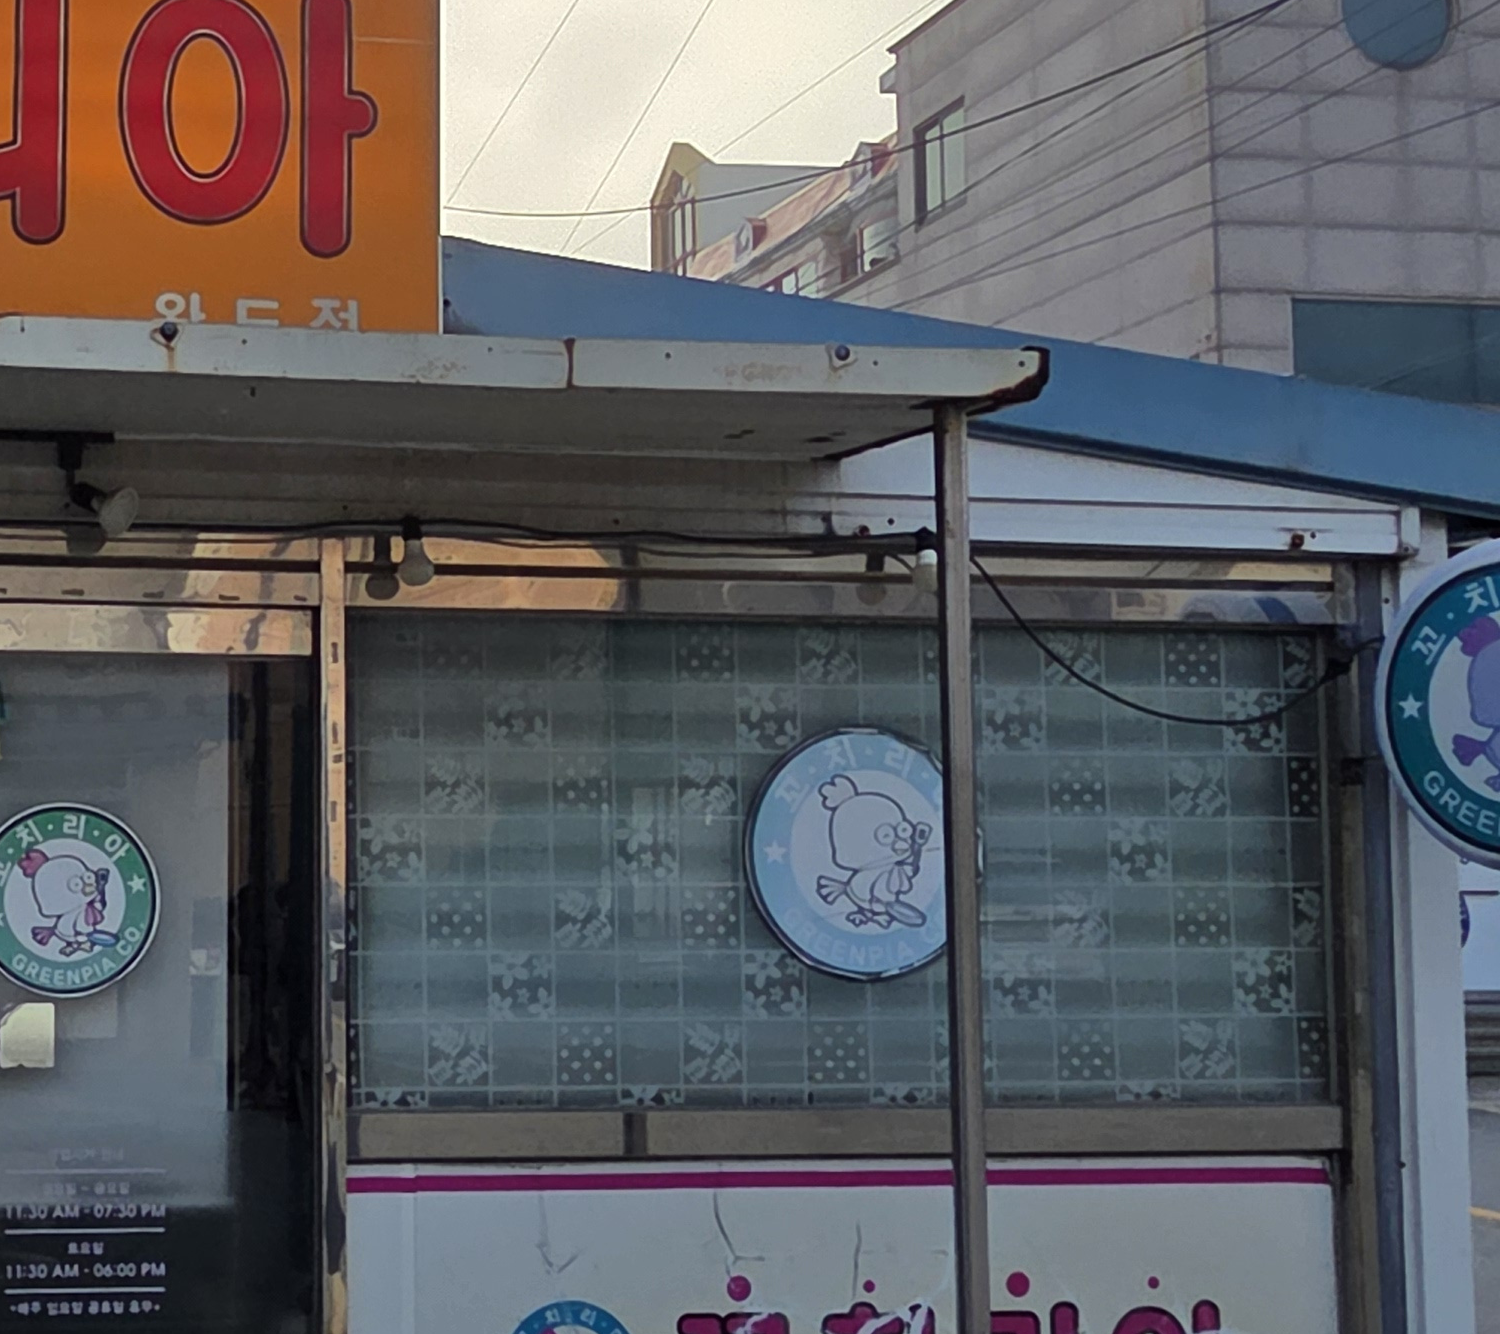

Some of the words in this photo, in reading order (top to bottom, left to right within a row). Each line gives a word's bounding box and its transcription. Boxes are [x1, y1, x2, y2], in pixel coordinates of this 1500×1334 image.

[1423, 770, 1500, 837] GREE
[11, 953, 117, 986] GREENPIA
[115, 923, 145, 957] CO.
[52, 1204, 80, 1218] AM
[93, 1203, 137, 1218] 07:30
[141, 1203, 167, 1218] PM
[5, 1264, 48, 1279] 11:30
[52, 1263, 80, 1278] AM
[93, 1263, 137, 1278] 06:00
[141, 1262, 167, 1278] PM
